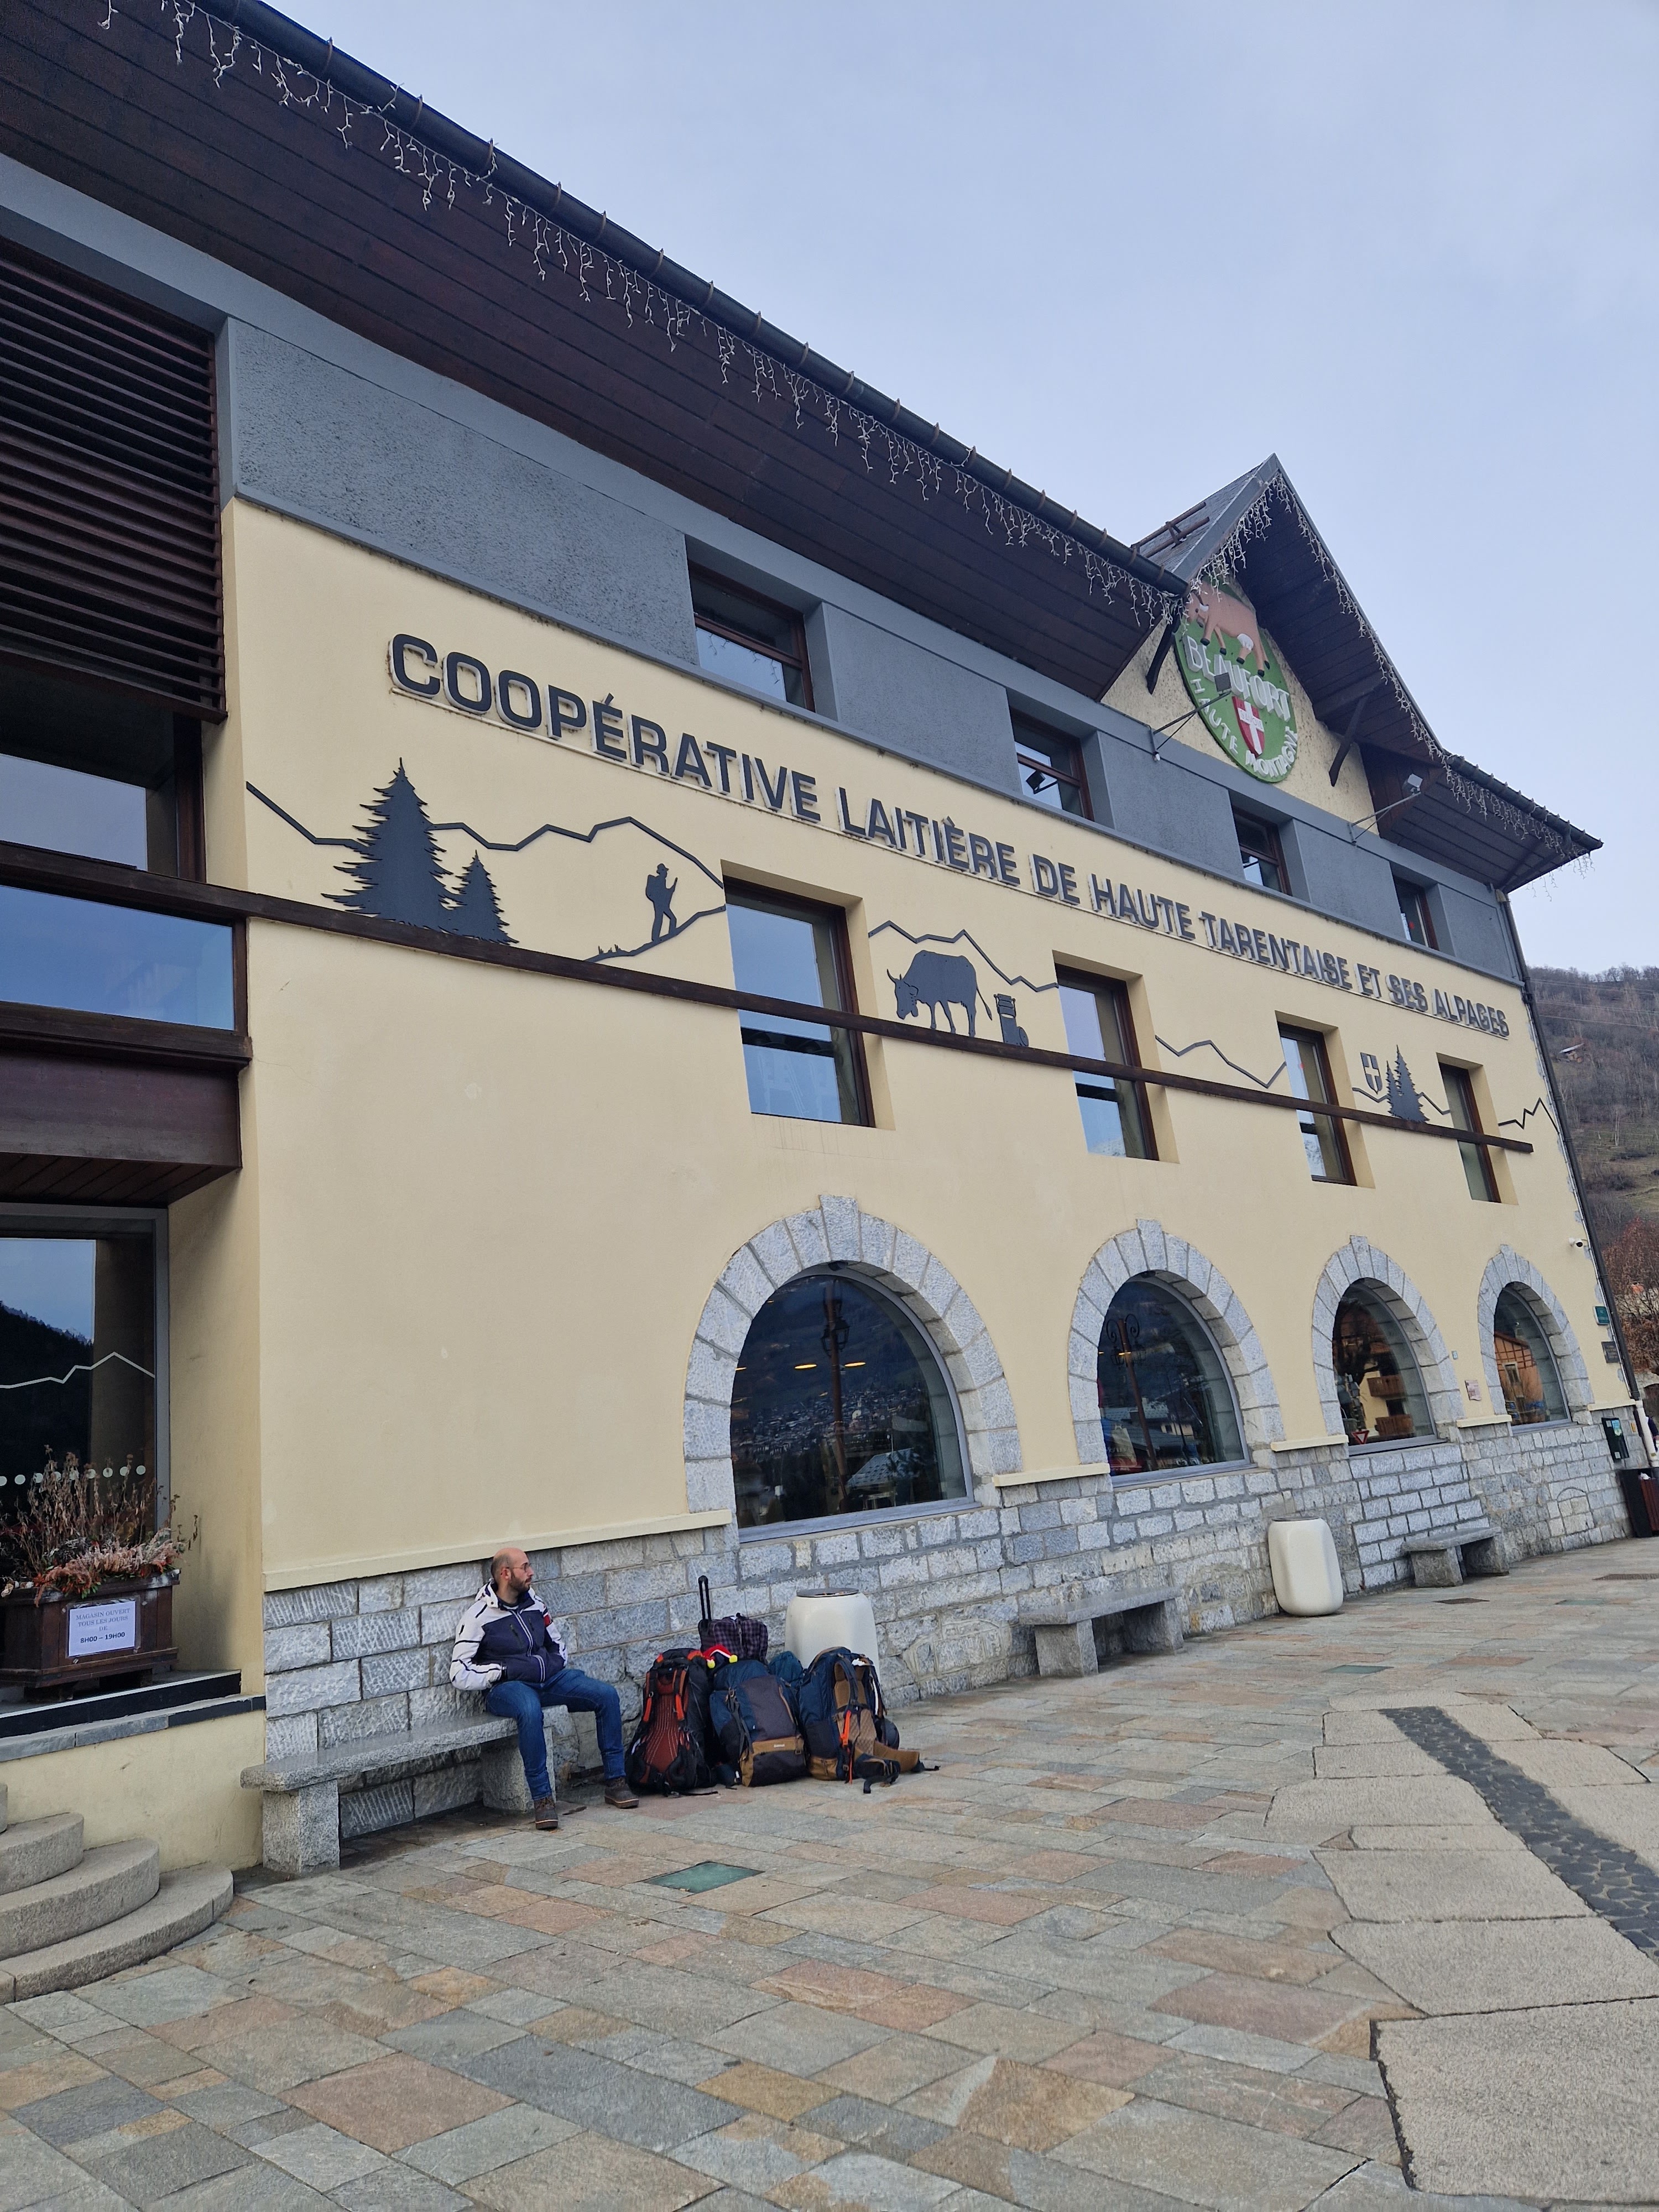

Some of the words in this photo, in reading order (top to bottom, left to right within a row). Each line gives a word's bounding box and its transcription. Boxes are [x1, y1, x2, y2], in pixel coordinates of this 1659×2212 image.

[1182, 635, 1295, 722] BEAUFORT
[1190, 679, 1239, 757] HAUTE
[1245, 726, 1298, 778] MONTAGNE
[389, 634, 822, 823] COOPÉRATIVE
[835, 786, 1020, 886] LAITIÈRE
[1029, 853, 1080, 905] DE
[1088, 873, 1196, 940] HAUTE
[1198, 911, 1353, 990] TARENTAISE
[1354, 963, 1381, 998] ET
[1385, 974, 1428, 1012] SES
[1431, 988, 1510, 1037] ALPAGES
[76, 1611, 104, 1620] MAGASIN
[105, 1631, 124, 1640] 19H00
